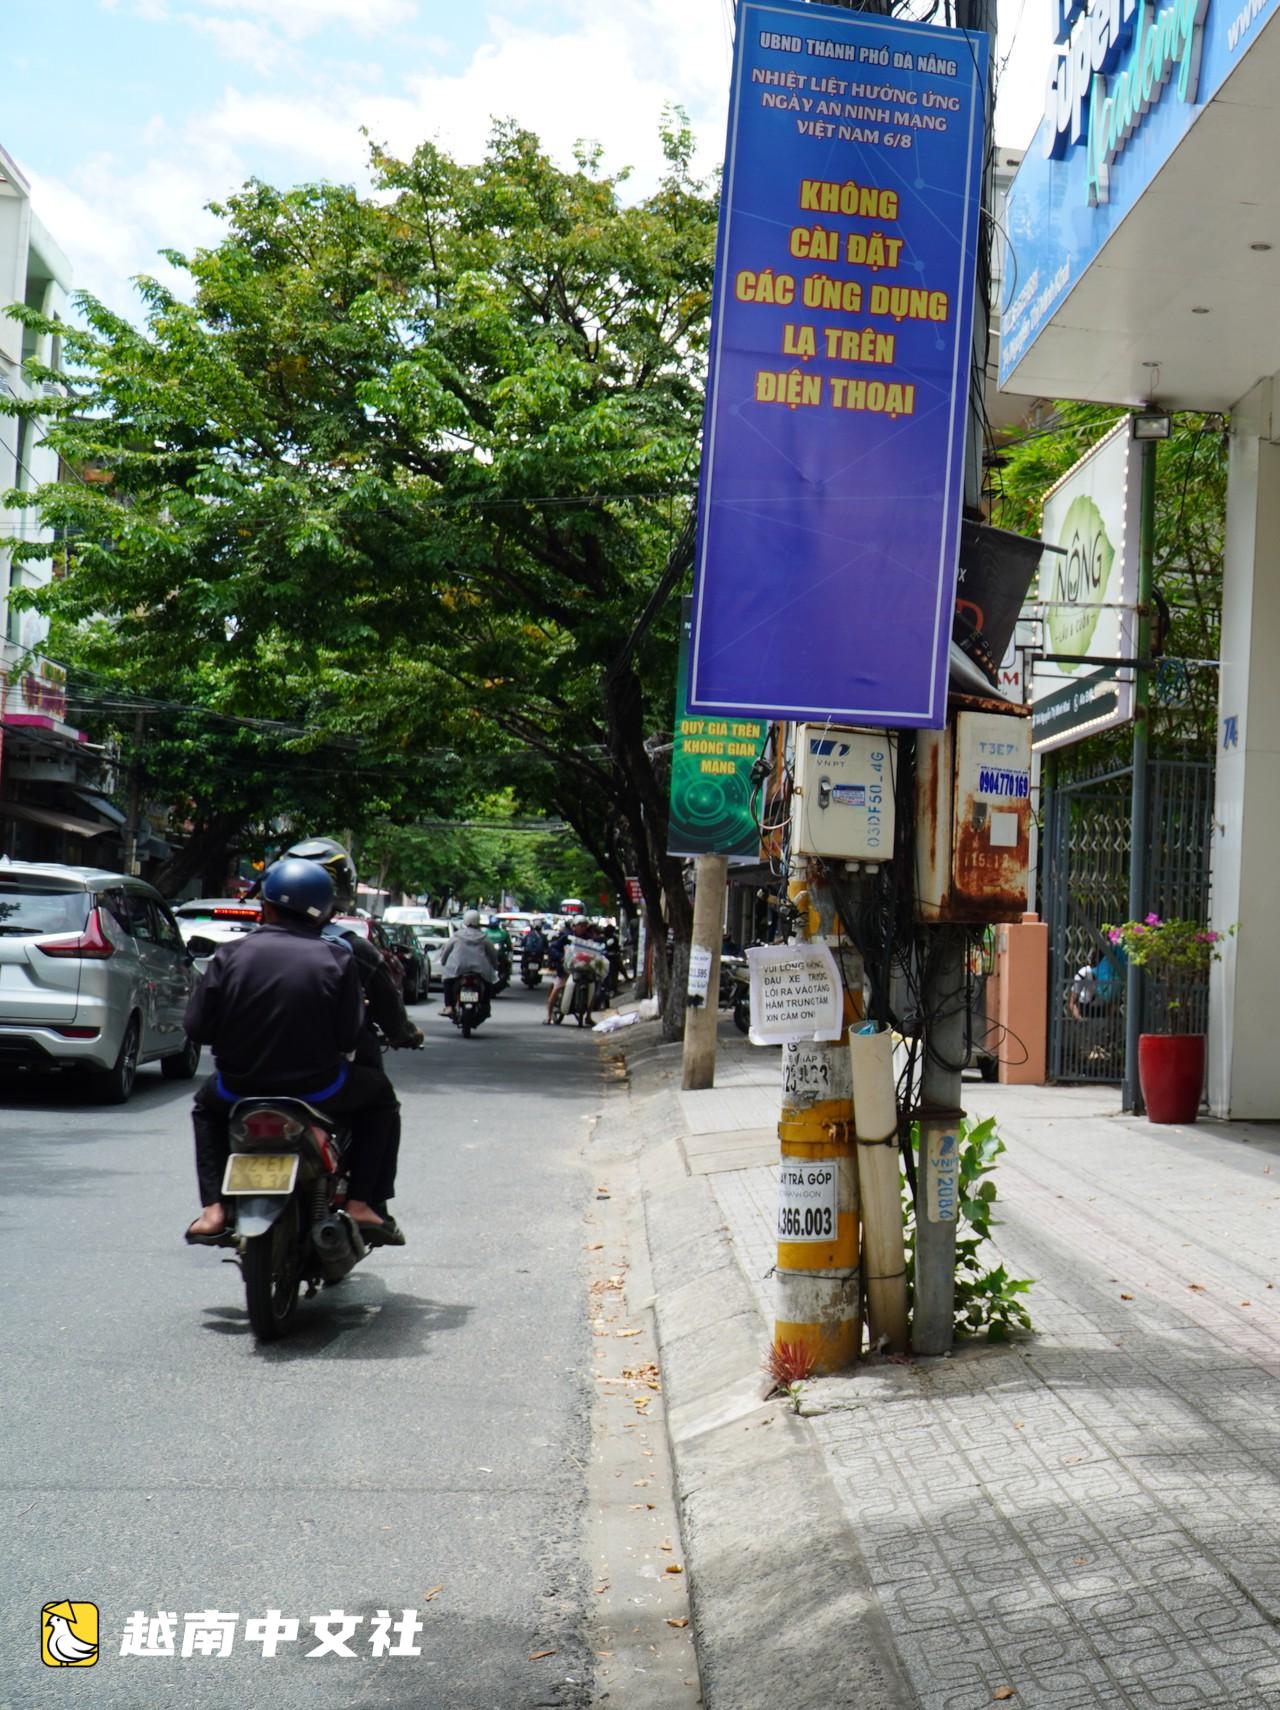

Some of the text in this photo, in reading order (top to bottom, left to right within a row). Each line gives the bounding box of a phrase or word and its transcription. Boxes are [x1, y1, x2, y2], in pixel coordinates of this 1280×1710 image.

[760, 32, 802, 54] UBND
[806, 39, 855, 62] THÀNH
[859, 46, 889, 67] PHỐ
[893, 52, 914, 71] ĐÀ
[752, 68, 961, 112] NHIỆT LIỆT HƯỞNG ỨNG
[762, 92, 947, 132] NGÀY AN NINH MẠNG
[797, 119, 912, 149] VIỆT NAM 6/8
[801, 179, 898, 220] KHÔNG
[790, 224, 903, 271] CÀI ĐẶT
[736, 268, 948, 322] CÁC ỨNG DỤNG
[783, 324, 894, 364] LẠ TRÊN
[756, 369, 915, 418] ĐIỆN THOẠI
[731, 722, 760, 739] TRÊN
[683, 739, 756, 757] KHÔNG GIAN
[816, 759, 845, 768] VNPT
[700, 759, 736, 777] MẠNG
[780, 987, 793, 997] RA
[789, 974, 801, 983] XE
[788, 1168, 805, 1185] TRẢ
[807, 1168, 832, 1185] GÓP
[778, 1206, 832, 1237] .366.003
